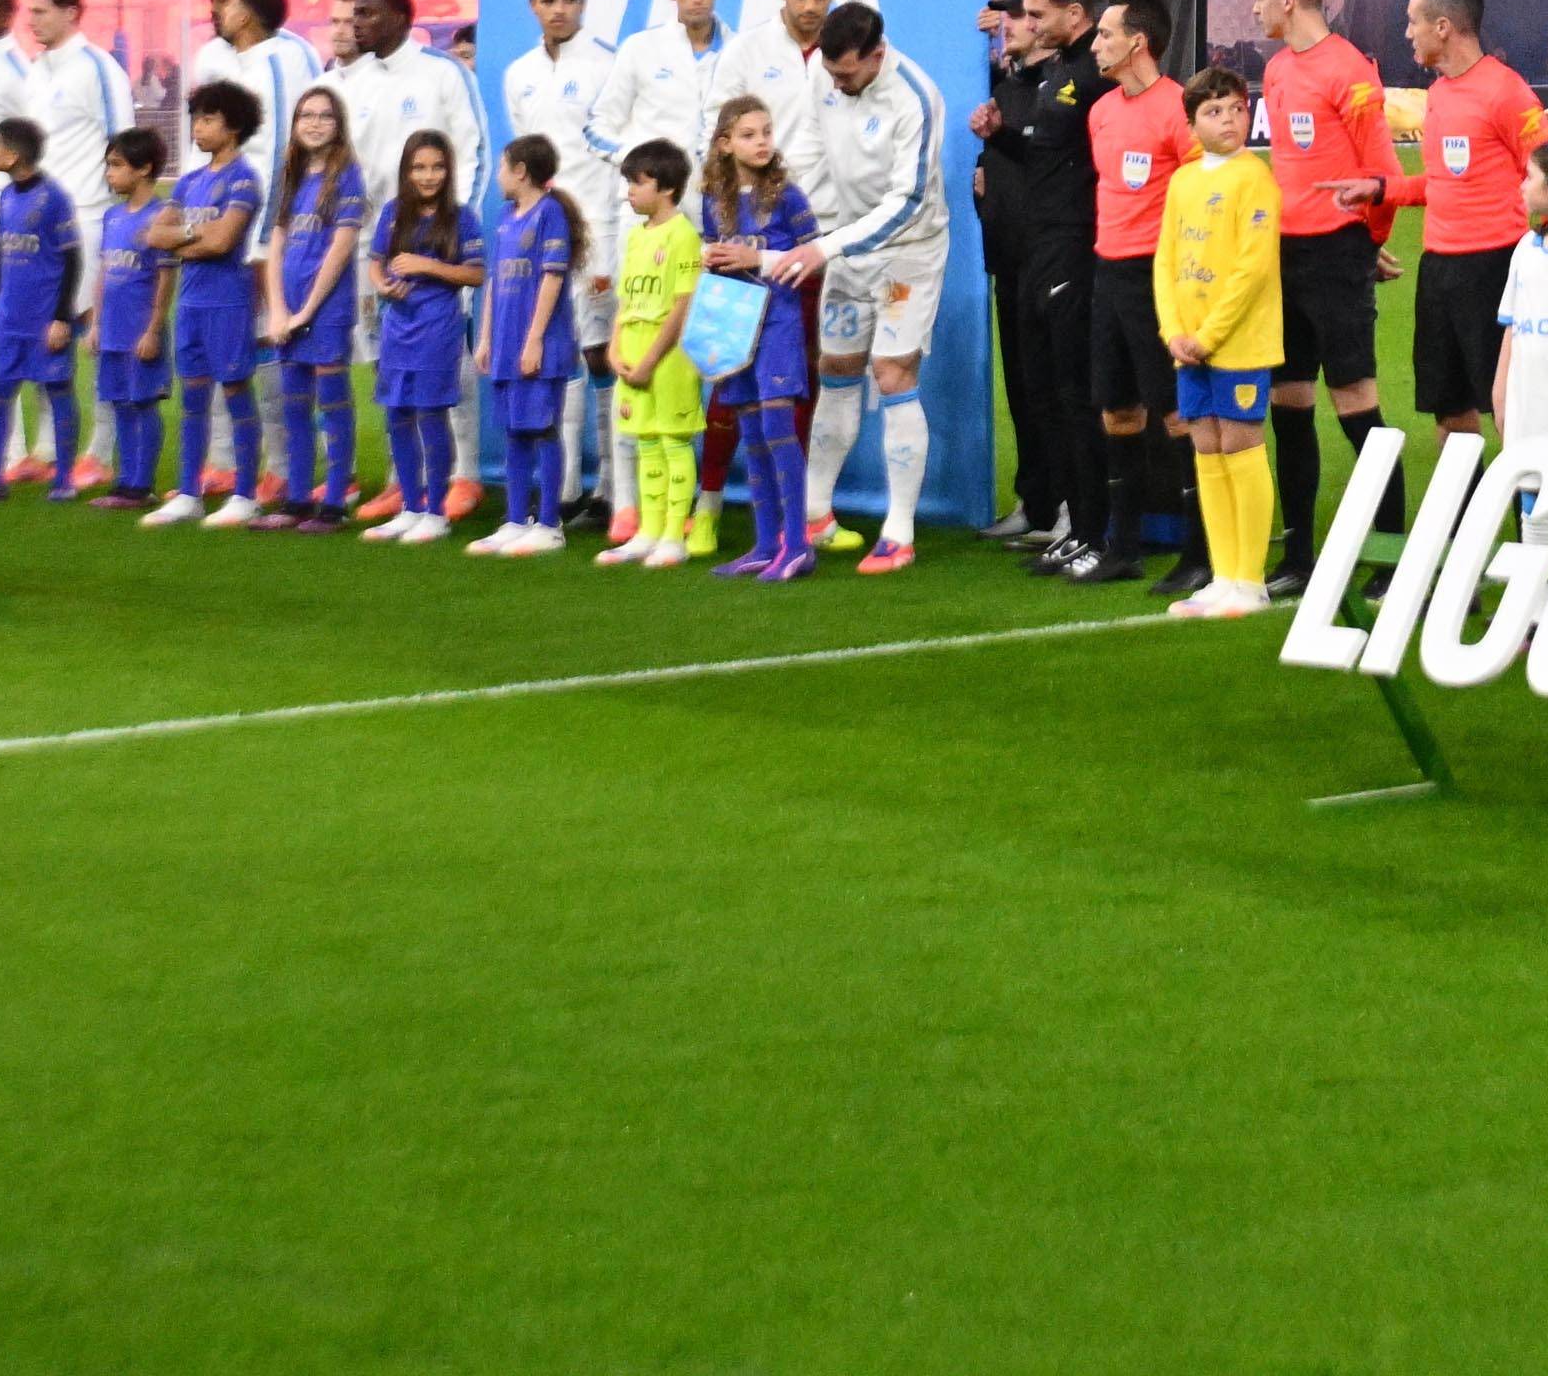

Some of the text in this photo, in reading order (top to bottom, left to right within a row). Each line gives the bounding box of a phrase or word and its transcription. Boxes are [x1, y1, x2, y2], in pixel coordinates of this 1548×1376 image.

[1291, 114, 1311, 124] FIFA
[1444, 138, 1467, 150] FIFA
[1125, 153, 1149, 165] FIFA
[822, 301, 860, 339] 23
